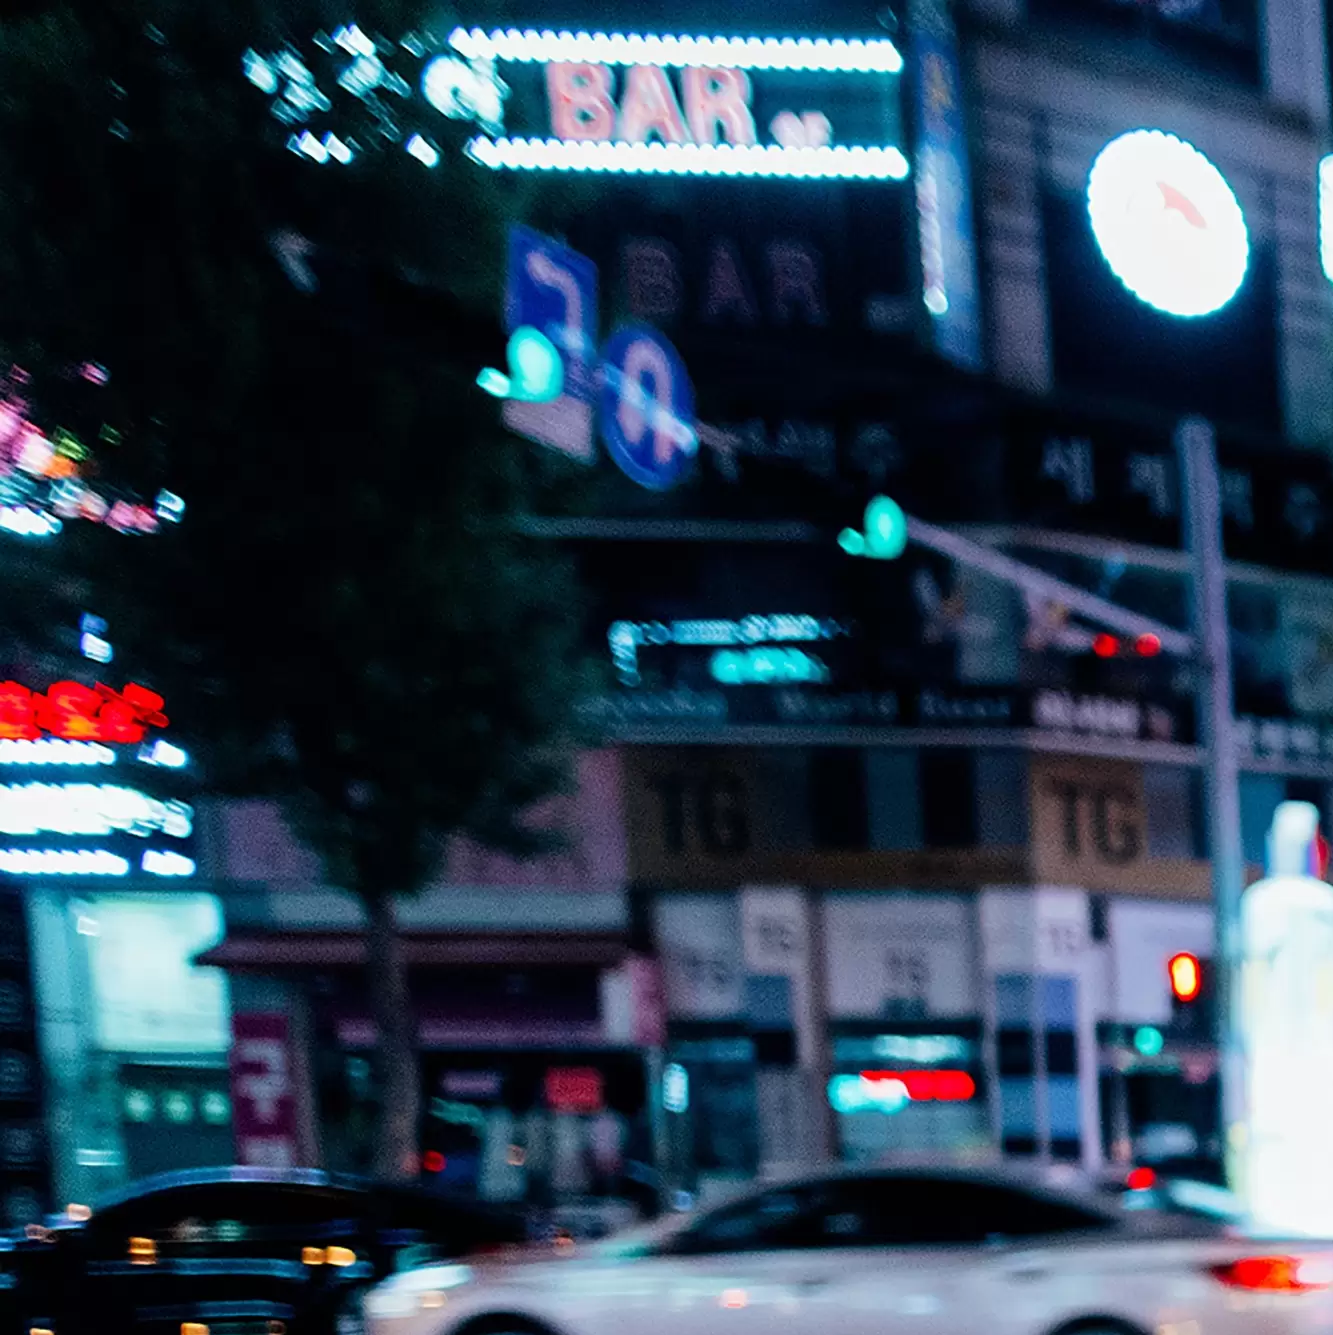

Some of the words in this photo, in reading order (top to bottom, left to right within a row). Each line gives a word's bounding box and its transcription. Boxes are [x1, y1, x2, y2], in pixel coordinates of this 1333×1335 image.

[546, 60, 758, 146] BAR
[622, 235, 826, 328] BAR
[1045, 774, 1144, 868] TG
